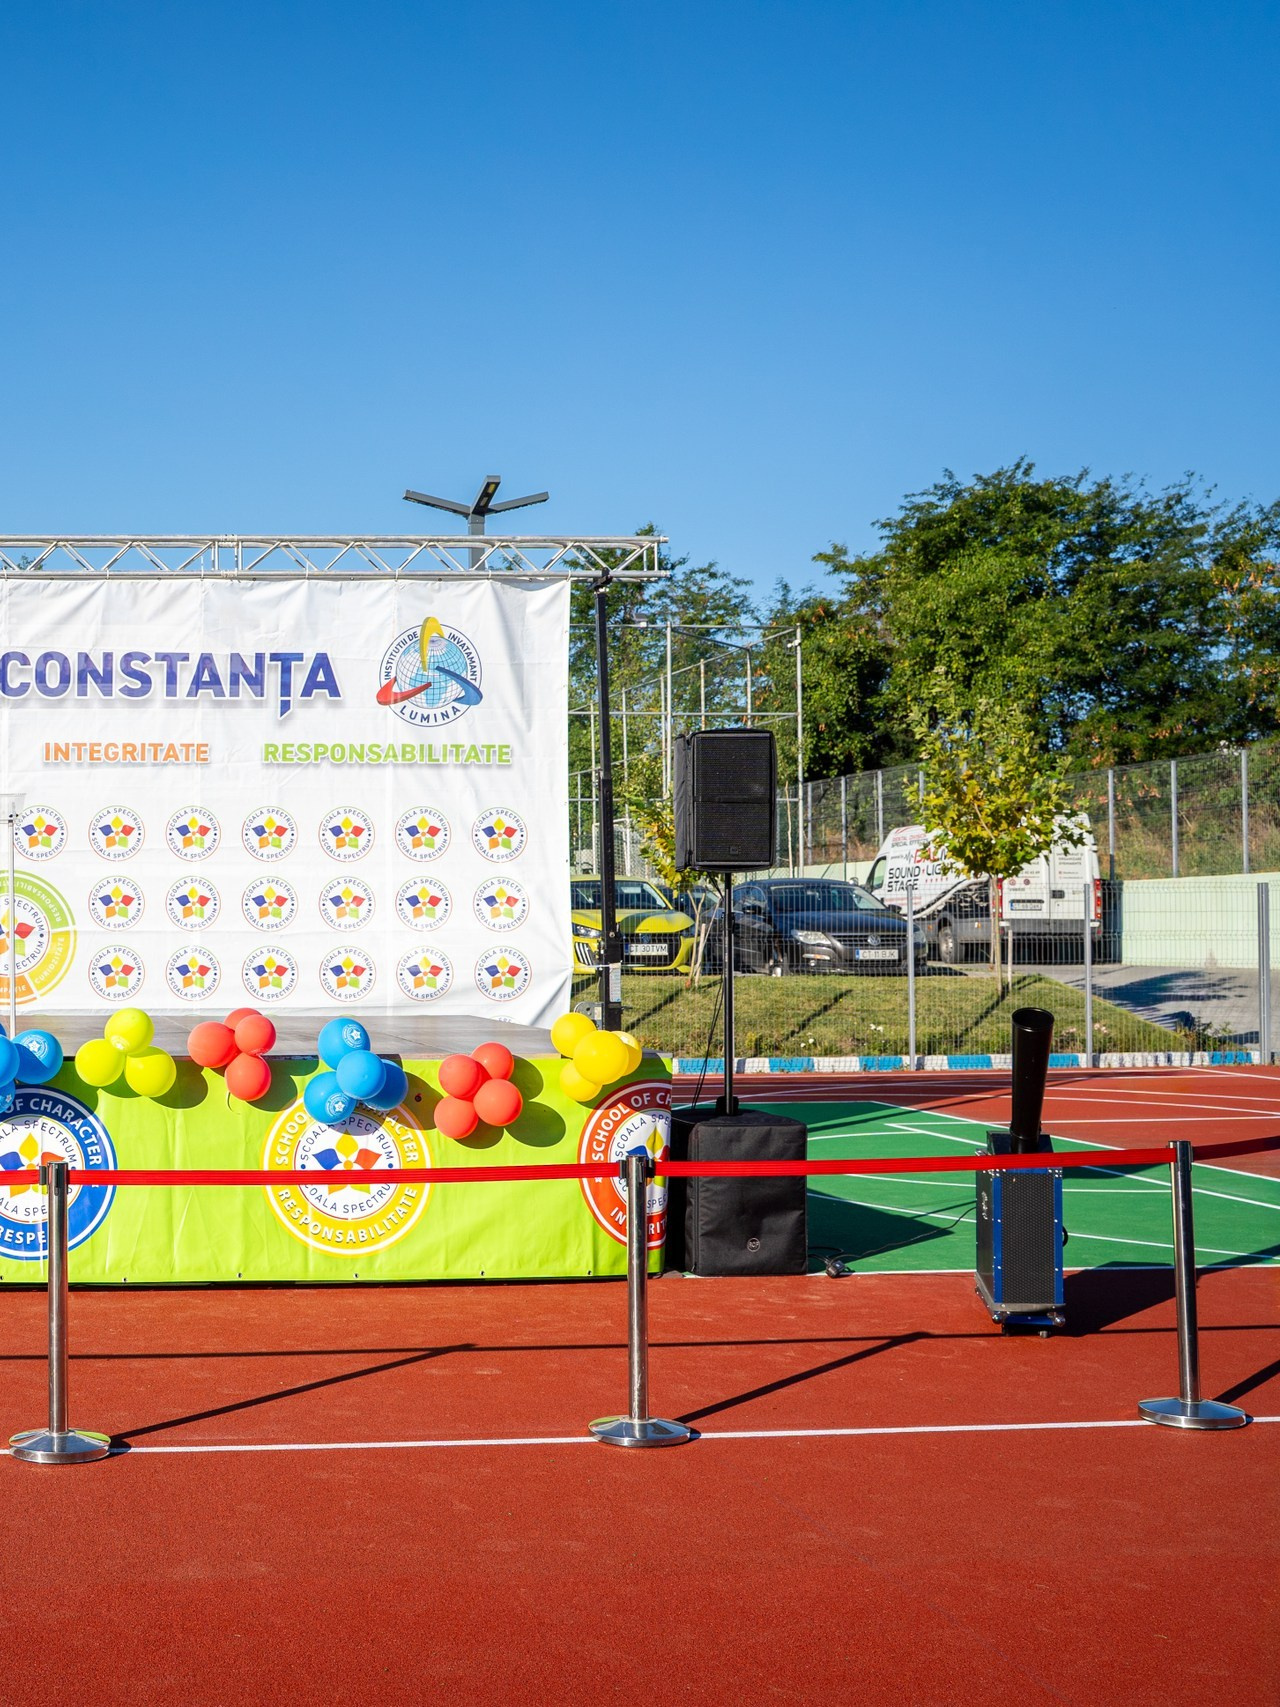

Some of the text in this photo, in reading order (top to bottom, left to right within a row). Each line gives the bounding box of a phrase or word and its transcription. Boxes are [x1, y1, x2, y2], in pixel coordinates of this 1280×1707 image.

[408, 631, 418, 641] DE
[400, 705, 461, 724] LUMINA
[44, 742, 209, 762] INTEGRITATE
[264, 744, 512, 764] RESPONSABILITATE
[114, 808, 142, 831] SPECTRUM
[267, 809, 295, 831] SPECTRUM
[497, 810, 524, 832] SPECTRUM
[114, 838, 142, 858] SPECTRUM
[266, 838, 294, 859] SPECTRUM
[496, 839, 524, 859] SPECTRUM
[888, 866, 920, 879] SOUND
[114, 878, 141, 901] SPECTRUM
[267, 879, 295, 901] SPECTRUM
[887, 878, 919, 892] STAGE
[113, 908, 141, 928] SPECTRUM
[266, 908, 294, 929] SPECTRUM
[4, 941, 44, 971] SECTRUM
[114, 948, 141, 970] SPECTRUM
[345, 948, 373, 971] SPECTRUM
[500, 949, 528, 971] SPECTRUM
[113, 977, 141, 998] SPECTRUM
[344, 978, 373, 999] SPECTRUM
[499, 978, 528, 998] SPECTRUM
[29, 1097, 102, 1166] CHARACTER
[592, 1092, 652, 1161] SCHOOL OF
[276, 1112, 308, 1166] SCHOO
[342, 1116, 394, 1160] SPECTRUM
[342, 1183, 391, 1214] SPECTRU
[278, 1186, 418, 1244] RESPONSABILITATE
